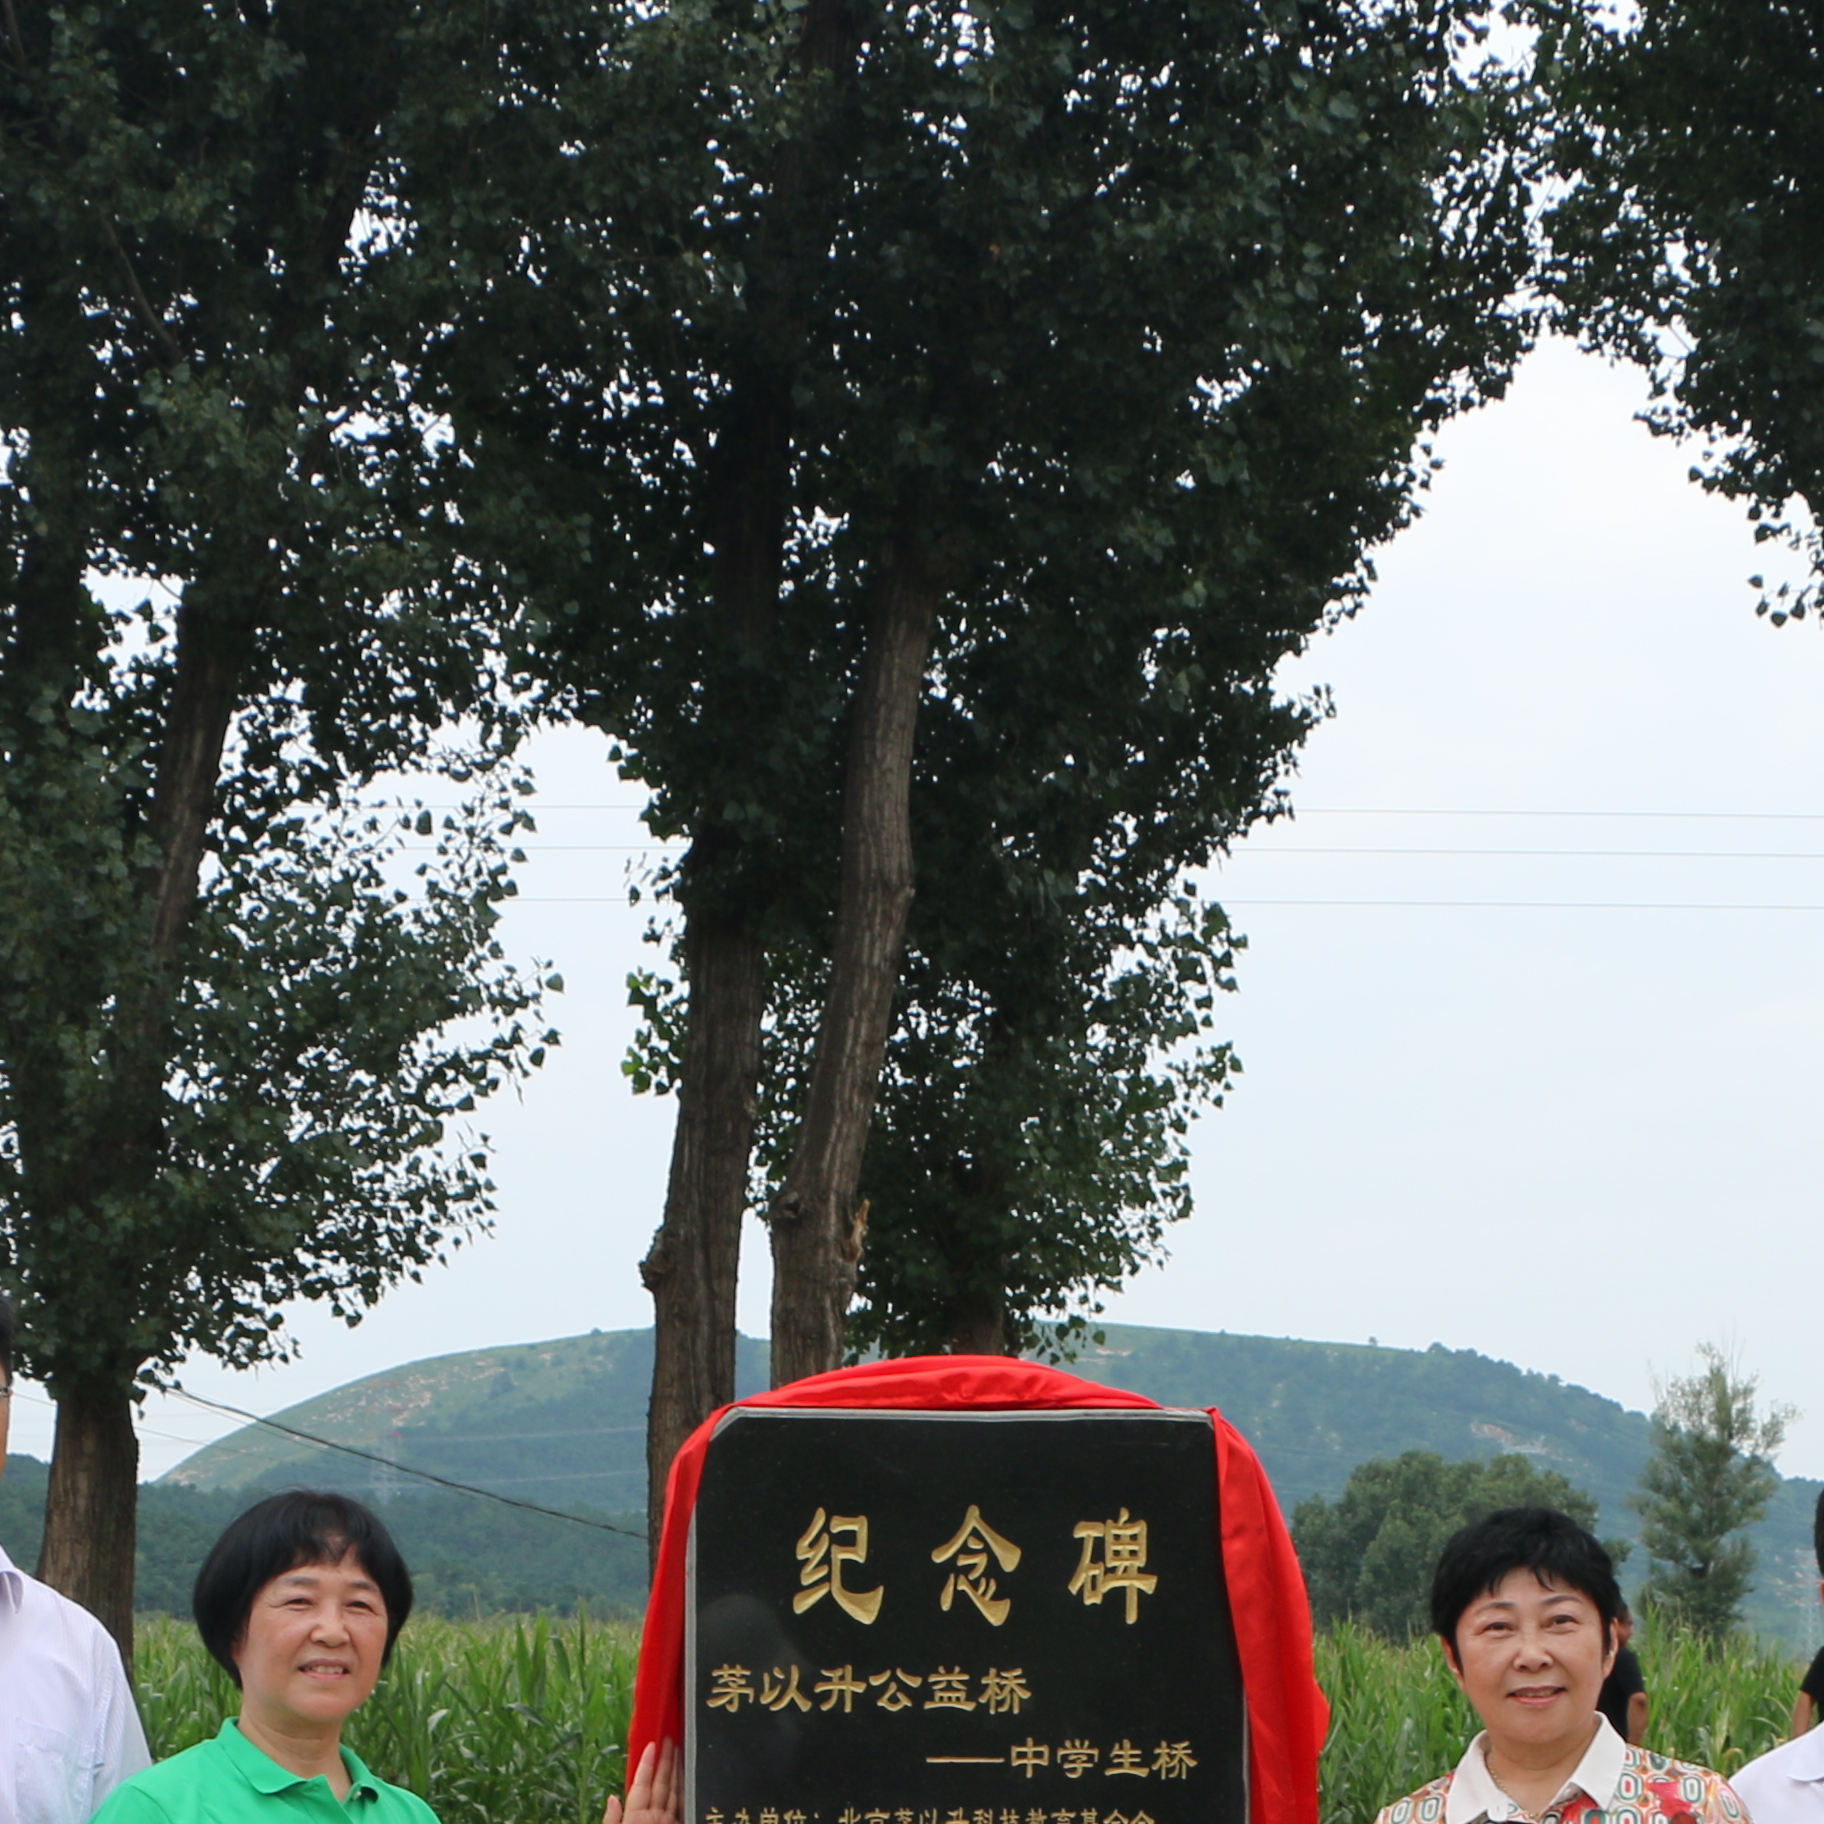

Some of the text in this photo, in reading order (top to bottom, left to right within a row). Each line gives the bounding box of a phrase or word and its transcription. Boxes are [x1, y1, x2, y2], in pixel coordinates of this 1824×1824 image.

[793, 1505, 1158, 1627] 纪念碑
[706, 1665, 1032, 1714] 茅以升公益桥
